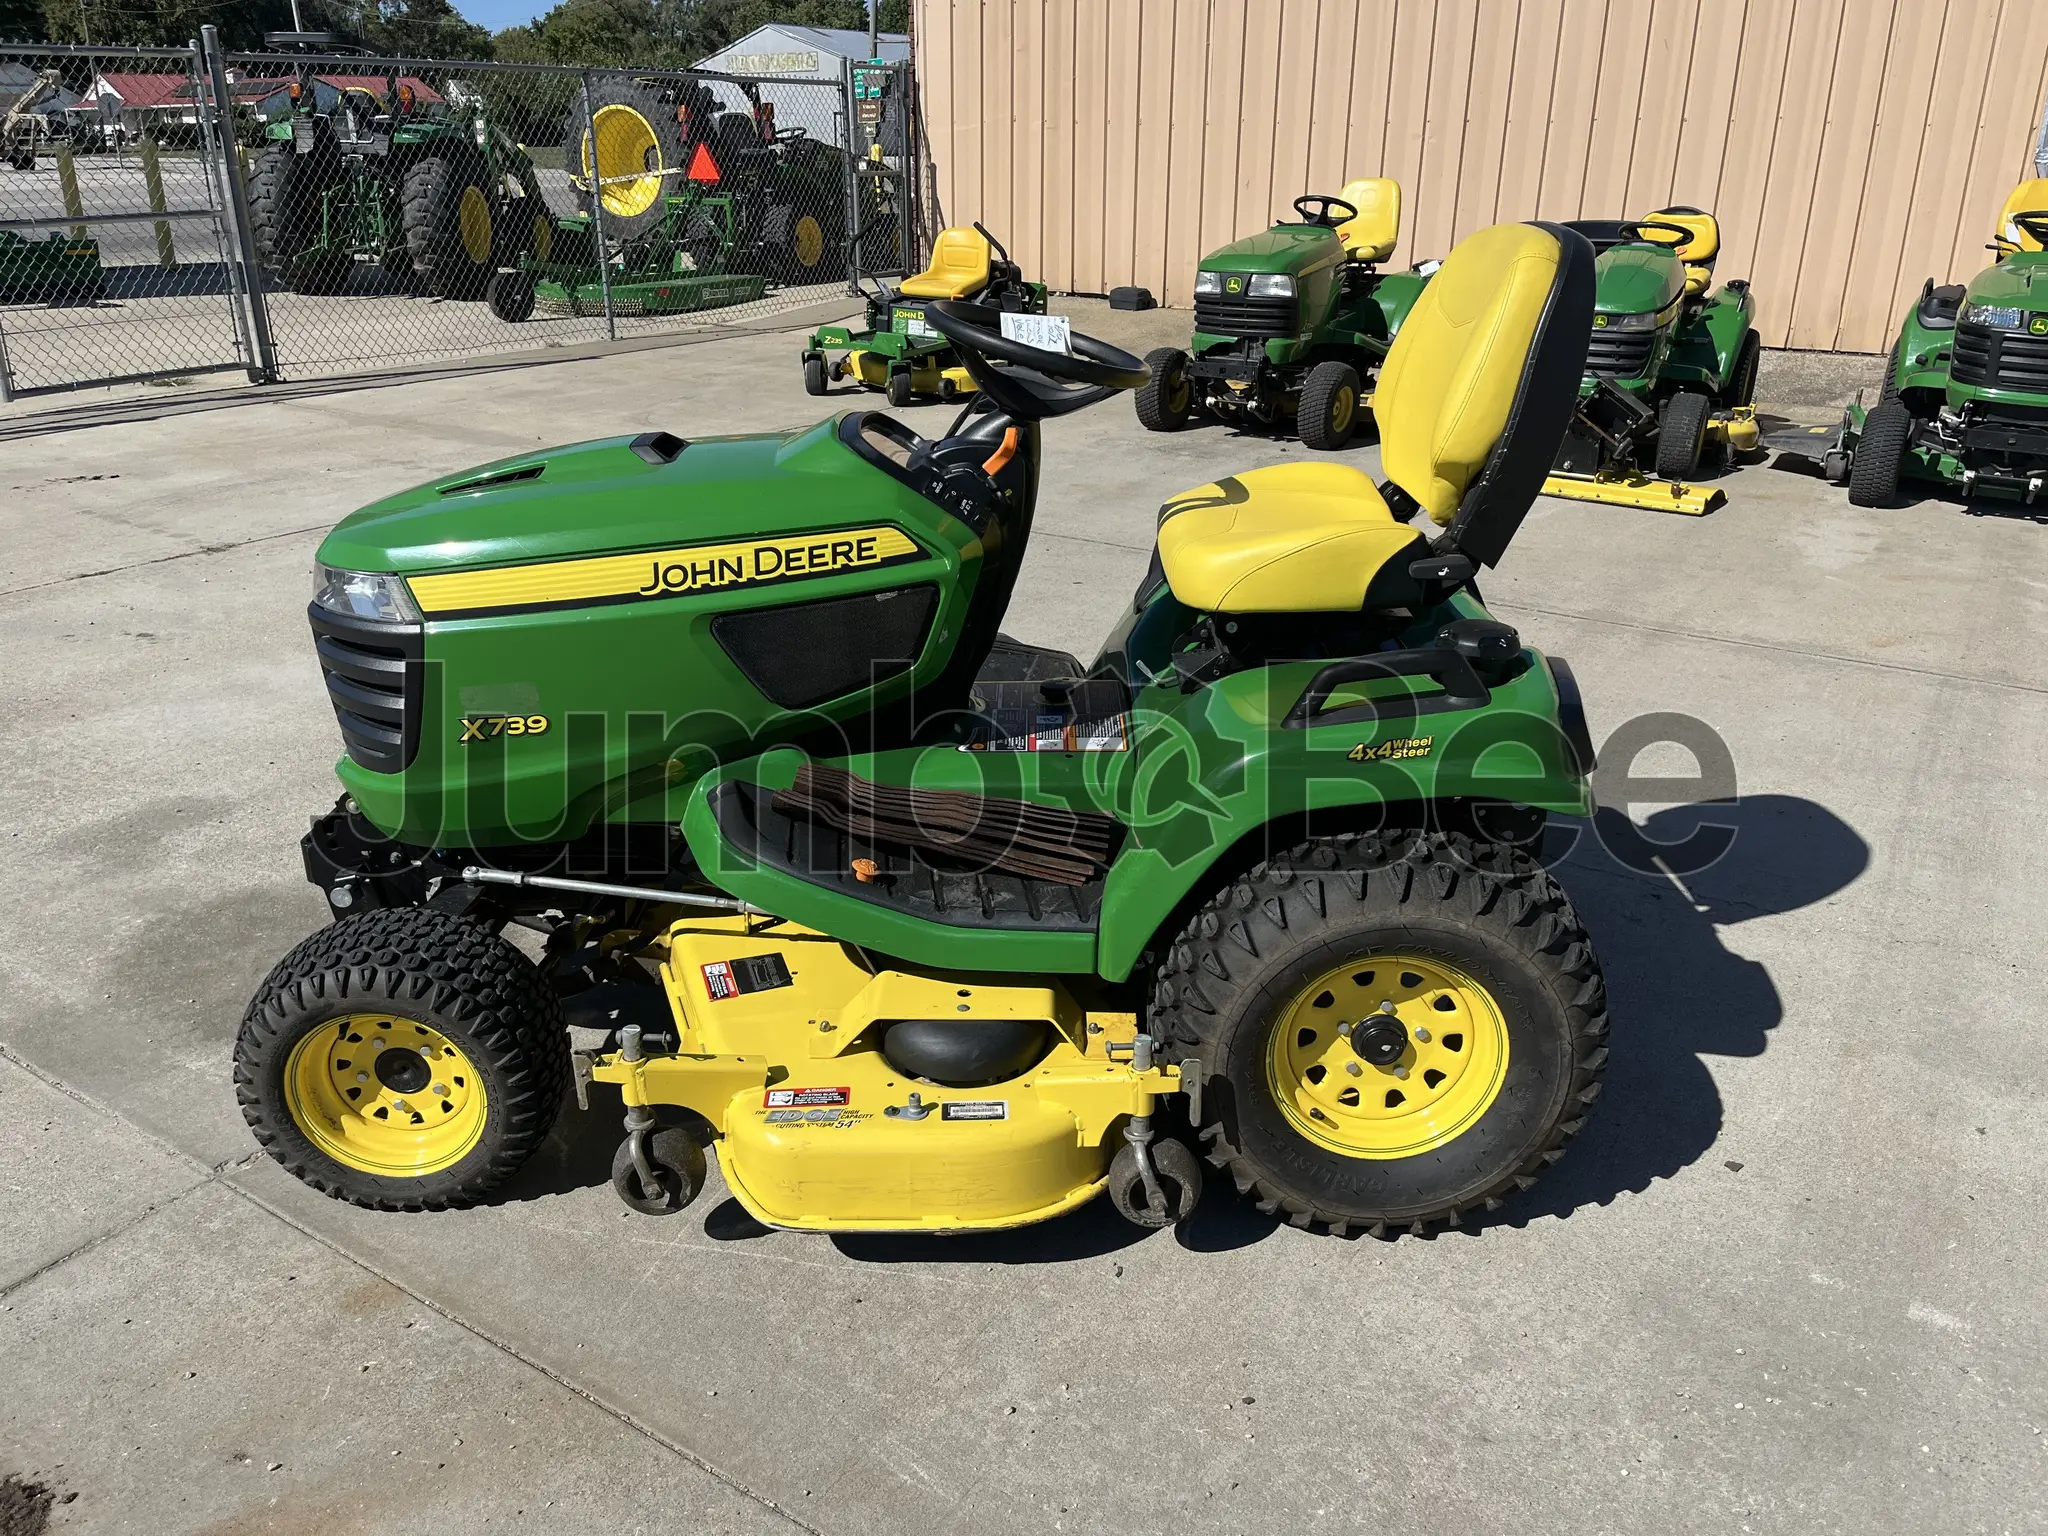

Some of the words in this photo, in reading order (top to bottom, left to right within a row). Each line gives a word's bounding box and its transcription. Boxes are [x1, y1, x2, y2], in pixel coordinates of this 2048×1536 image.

[894, 309, 917, 320] JOHN
[824, 336, 843, 345] Z235
[639, 555, 746, 595] JOHN
[752, 535, 881, 580] DEERE
[459, 714, 549, 742] X739
[1347, 741, 1393, 762] 4x4
[1392, 735, 1433, 749] Wheel
[1392, 747, 1431, 759] Steer
[763, 1109, 843, 1124] EDGE
